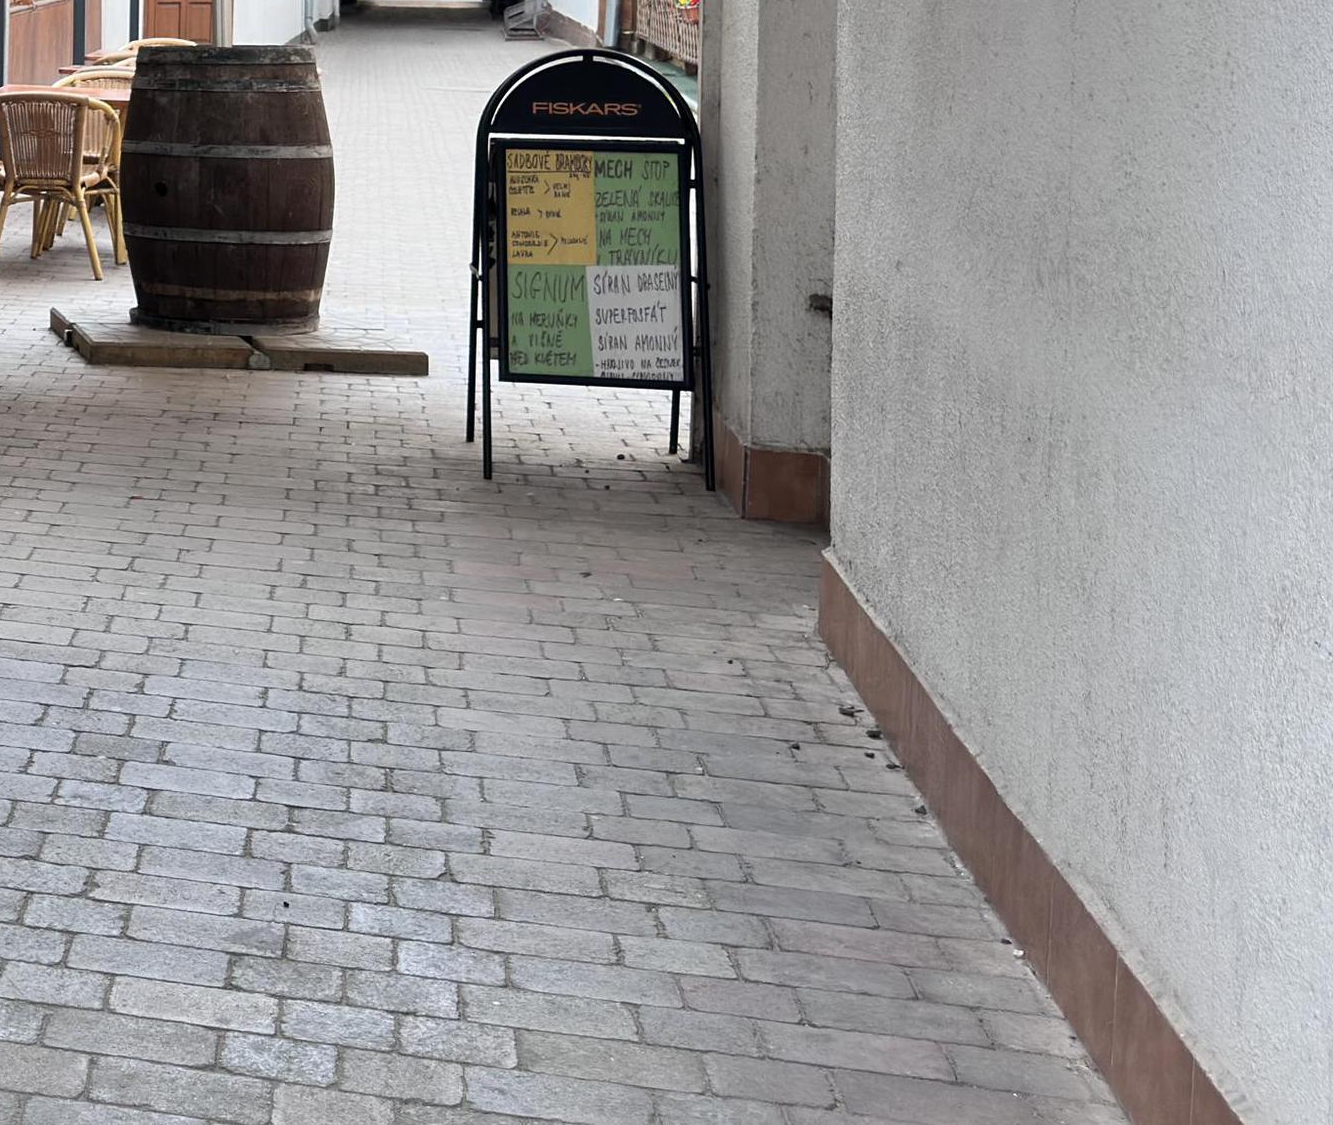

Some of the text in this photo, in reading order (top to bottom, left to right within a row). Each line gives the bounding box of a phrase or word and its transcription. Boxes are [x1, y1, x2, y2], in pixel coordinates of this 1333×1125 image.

[507, 150, 551, 171] SADBOVÉ
[594, 159, 671, 181] MECH STOP
[595, 184, 643, 208] ZELENÁ
[599, 227, 652, 248] NA MECH
[511, 271, 585, 303] SIGNUM
[593, 269, 632, 295] SÍRAN
[595, 300, 667, 326] SUPERFOSFÁT
[598, 325, 679, 353] SÍRAN AMONNÝ
